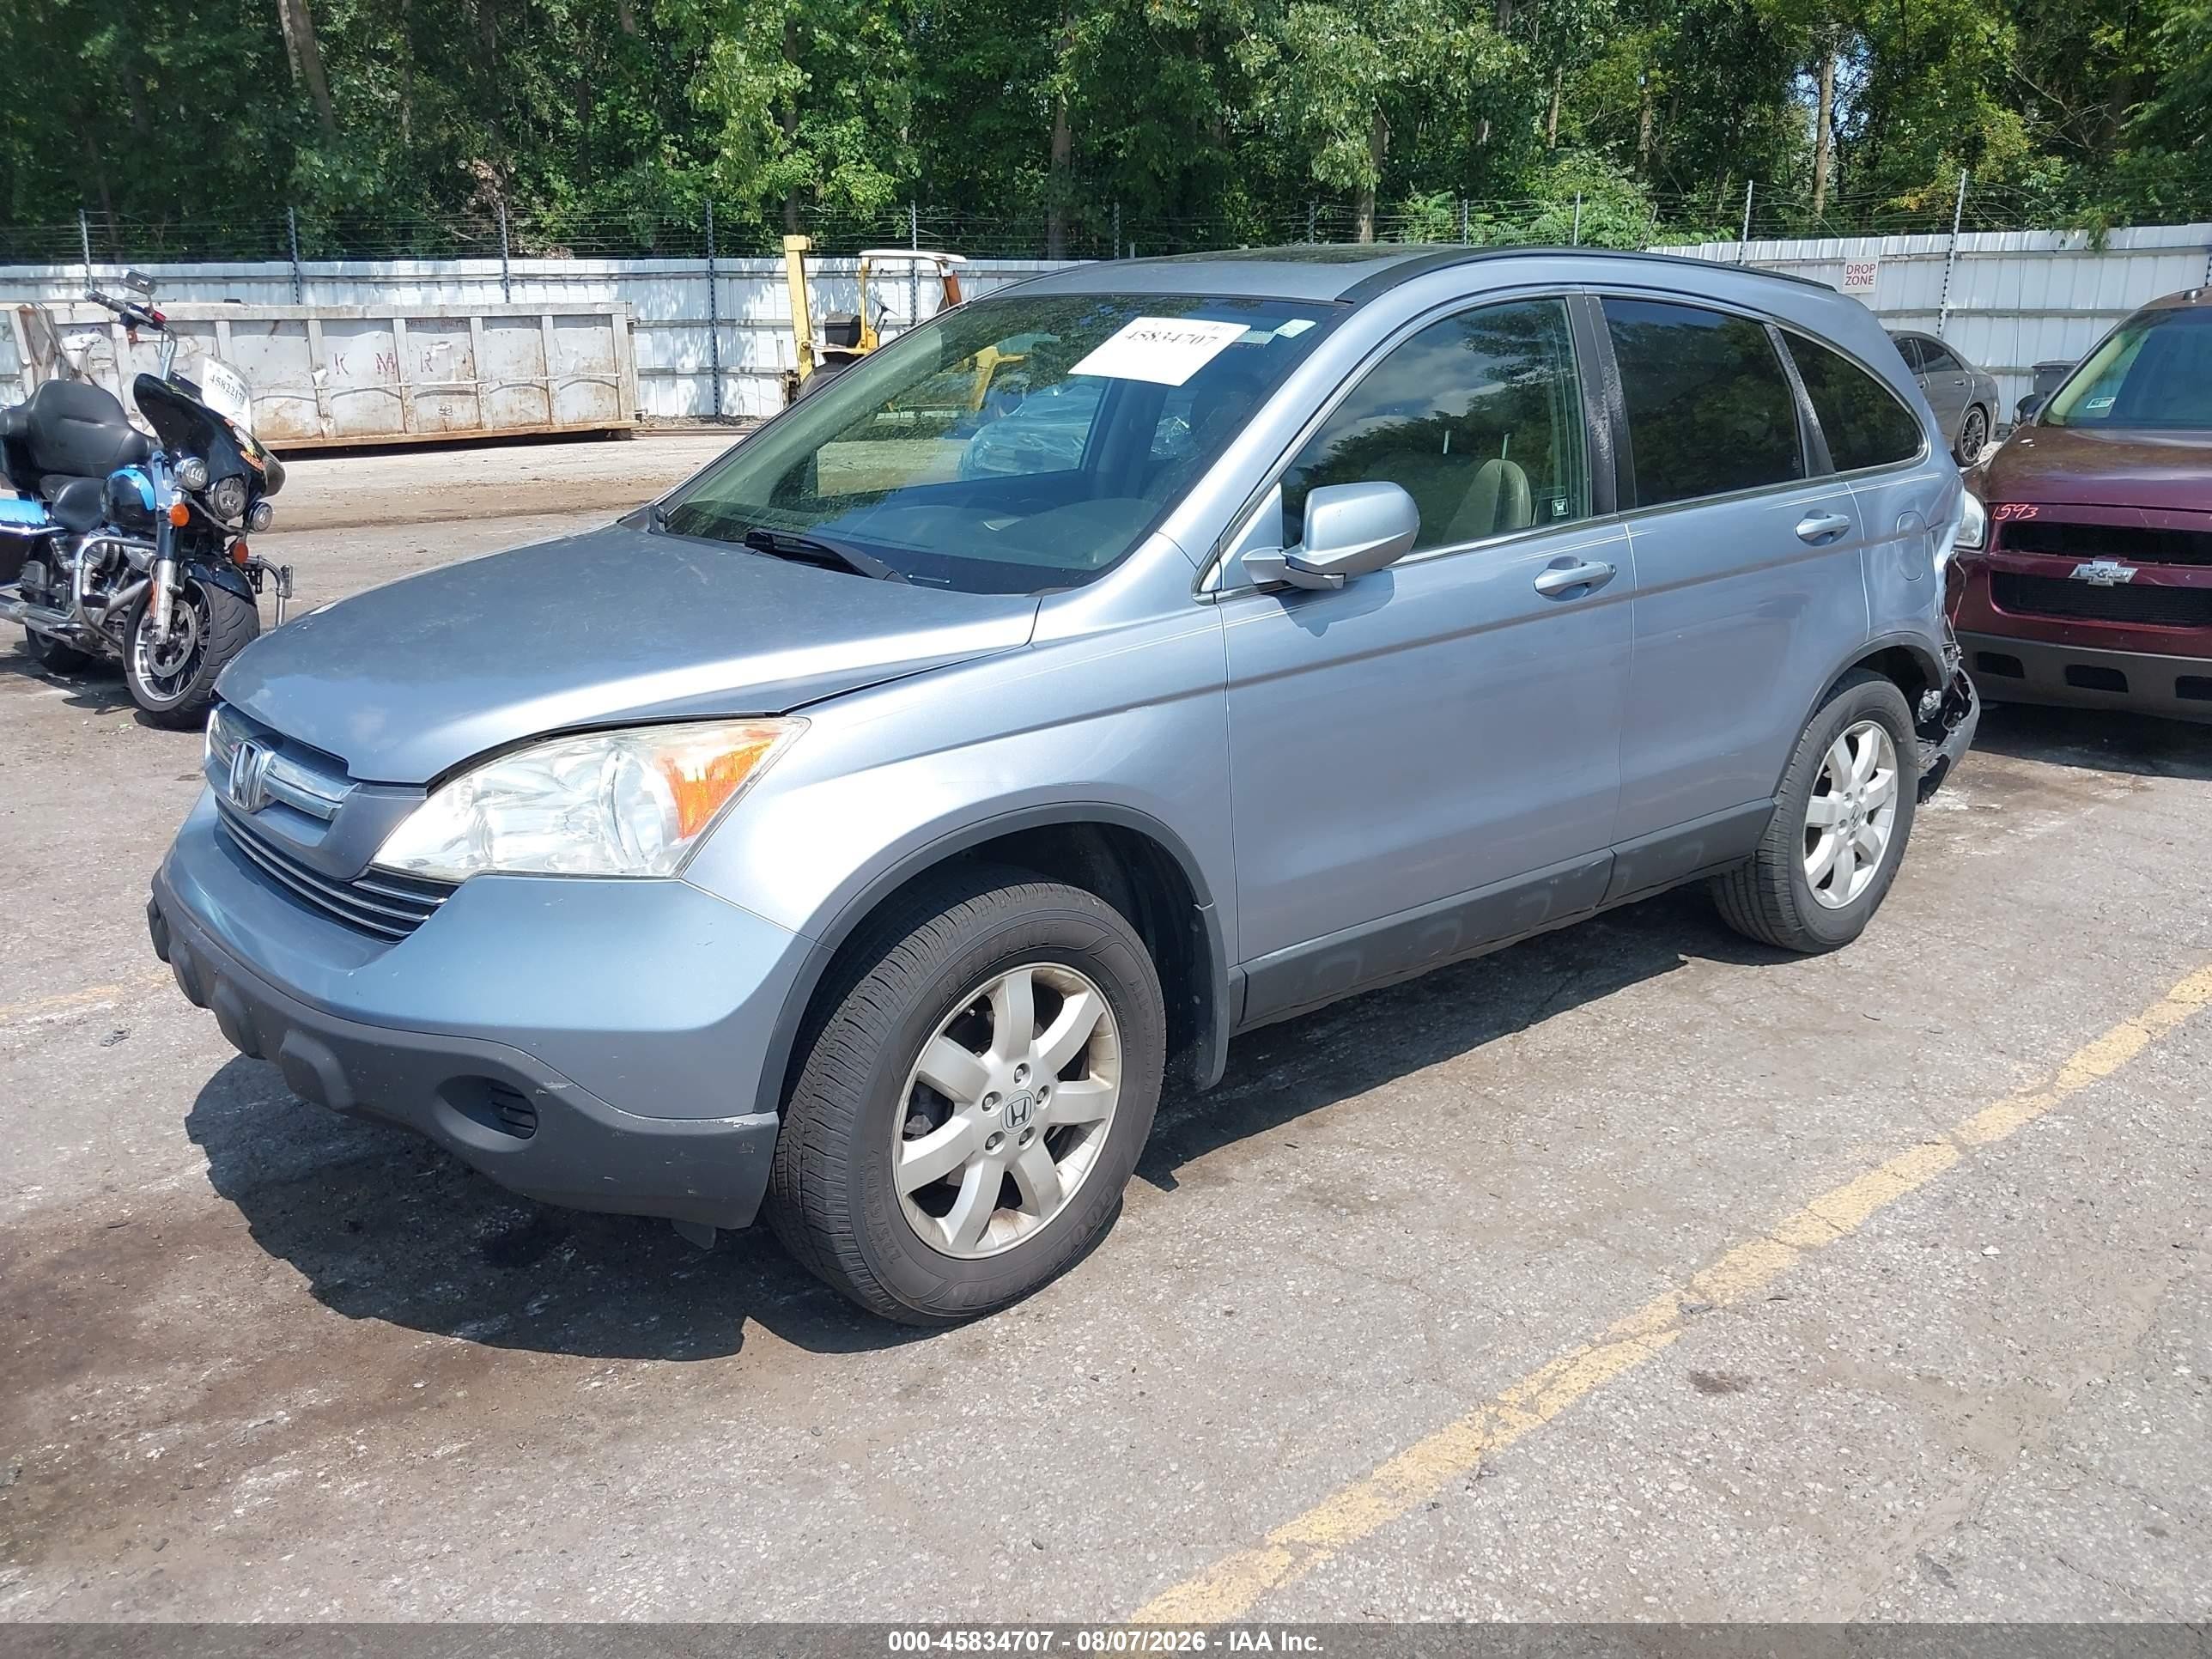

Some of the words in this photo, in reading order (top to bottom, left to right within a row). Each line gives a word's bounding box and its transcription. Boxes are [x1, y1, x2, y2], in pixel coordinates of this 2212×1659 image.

[1846, 264, 1876, 275] DROP
[1844, 275, 1875, 286] ZONE
[1125, 329, 1220, 347] 45834707
[334, 352, 350, 376] K
[1991, 503, 2039, 520] 1593
